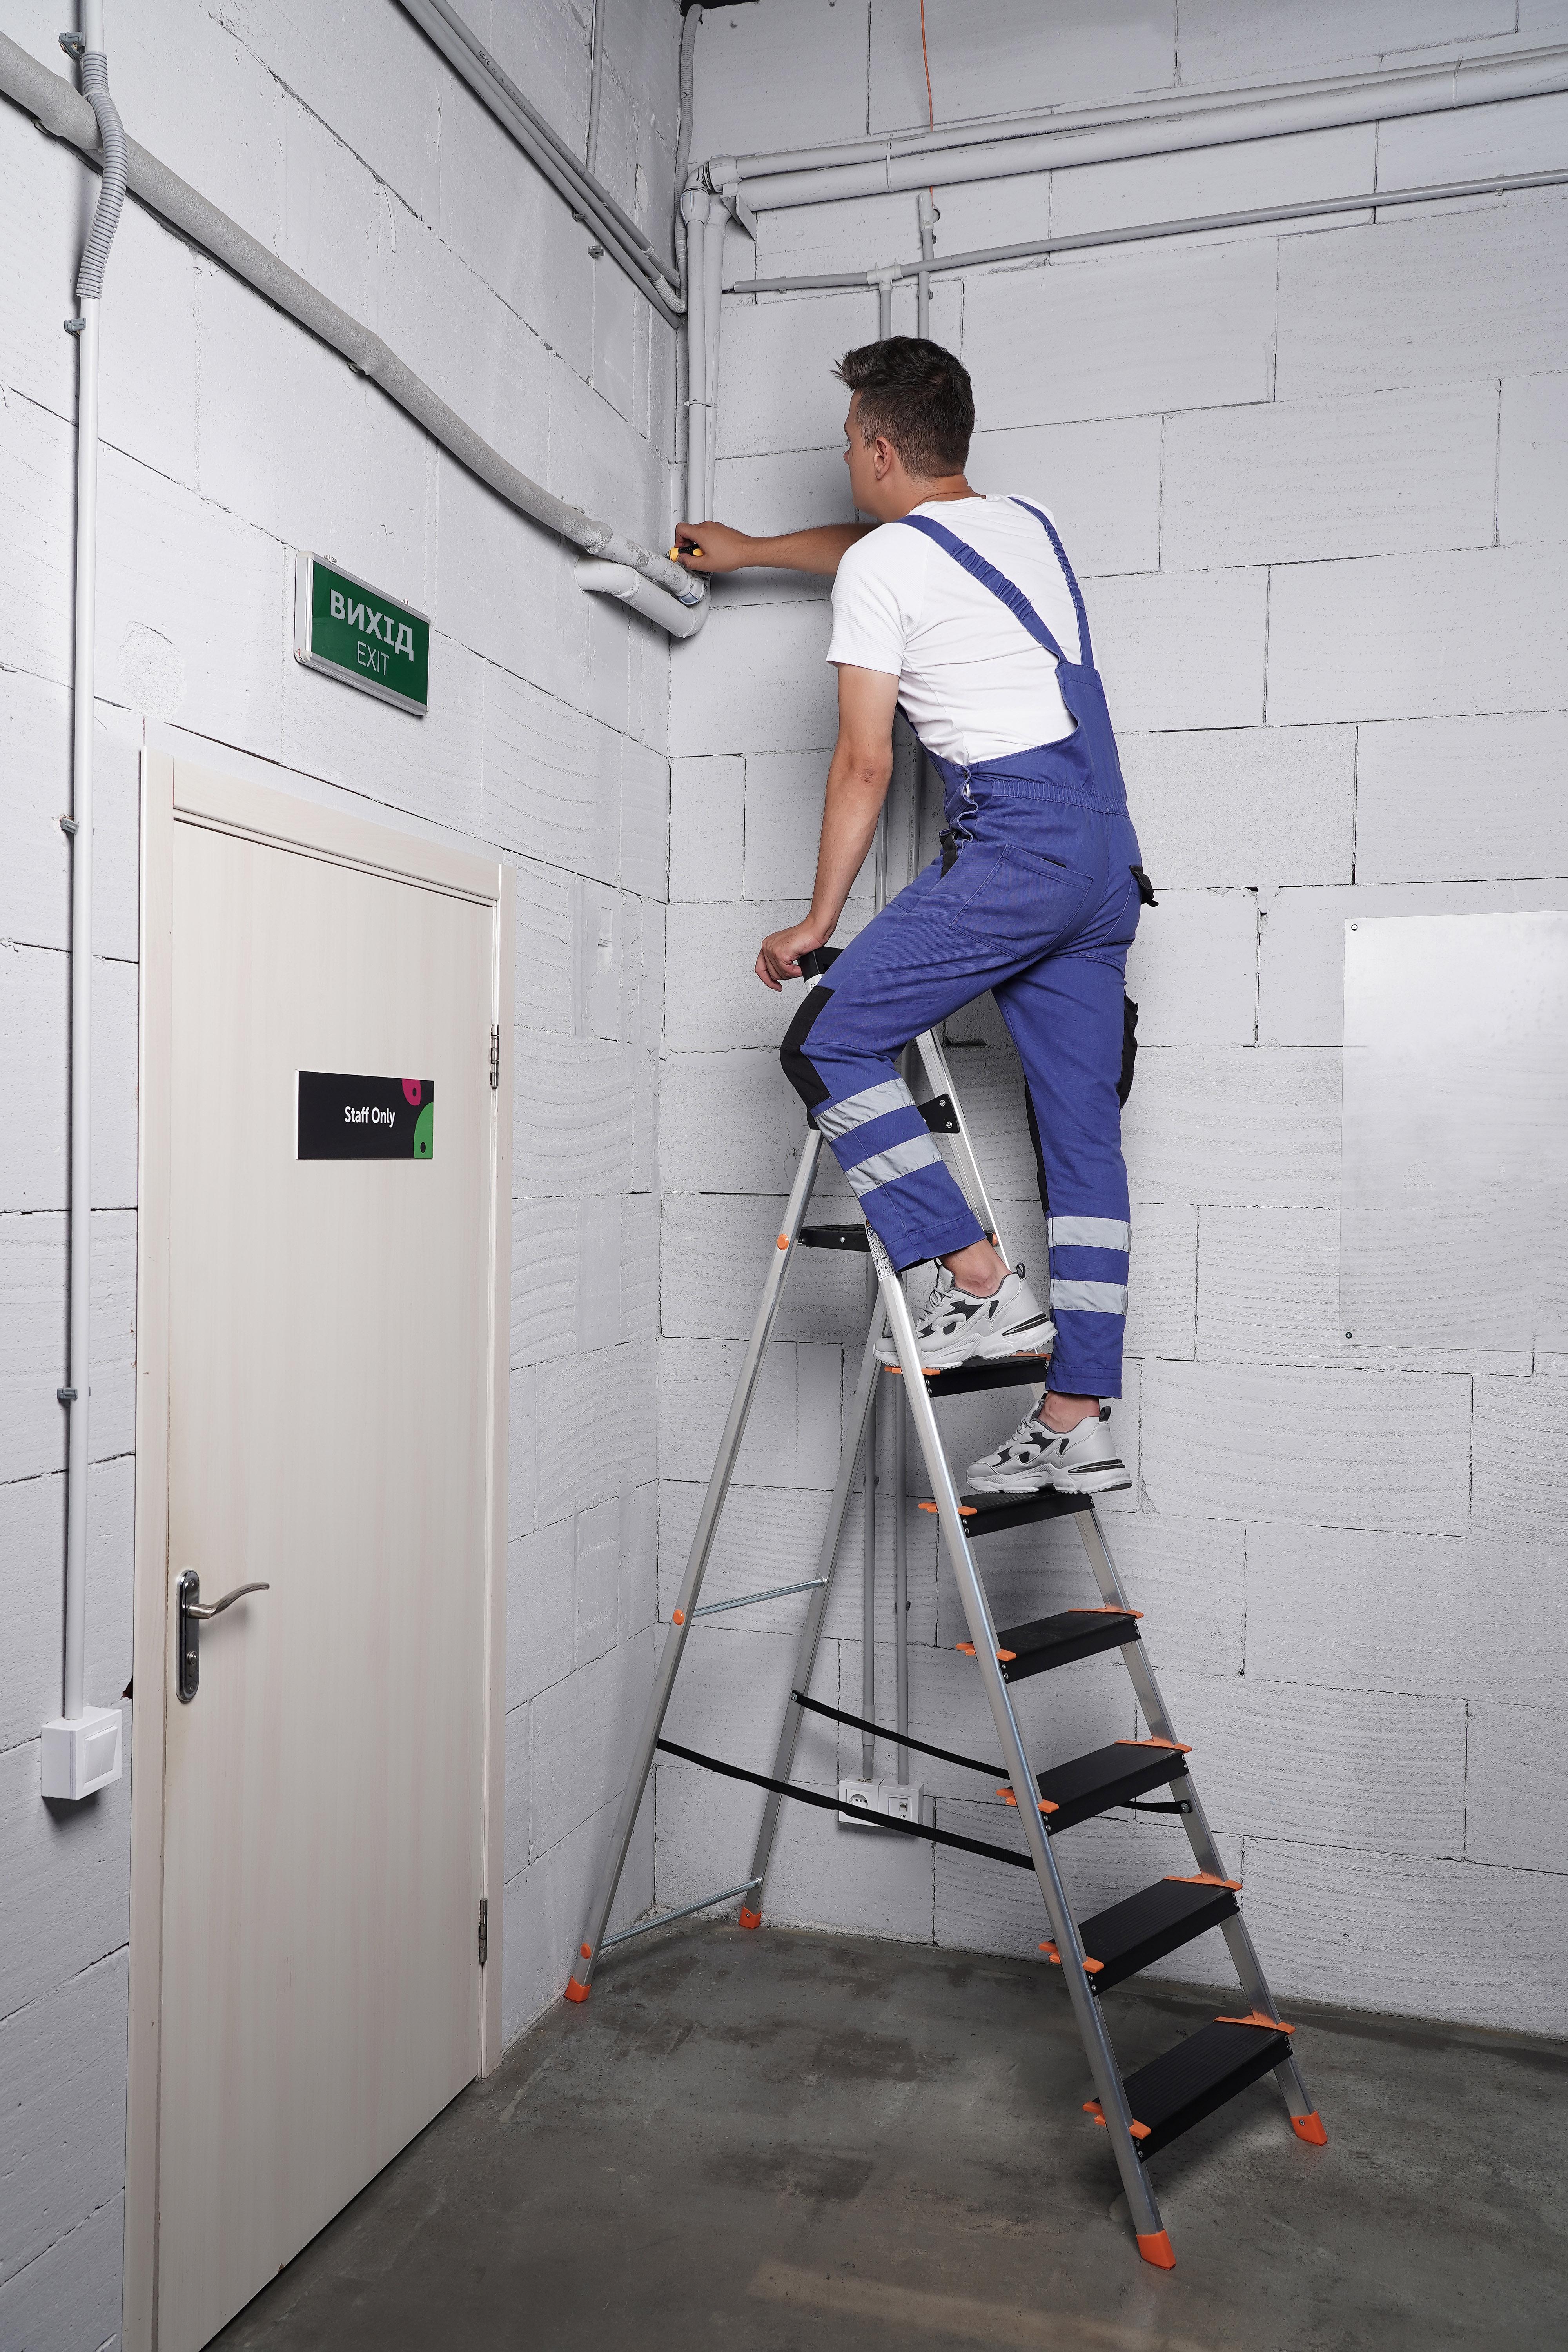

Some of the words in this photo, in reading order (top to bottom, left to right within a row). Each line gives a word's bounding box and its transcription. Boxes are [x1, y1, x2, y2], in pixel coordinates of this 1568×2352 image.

[330, 589, 414, 662] ВИХІД
[357, 640, 390, 676] EXIT
[344, 1106, 370, 1123] Staff
[371, 1107, 396, 1128] Only
